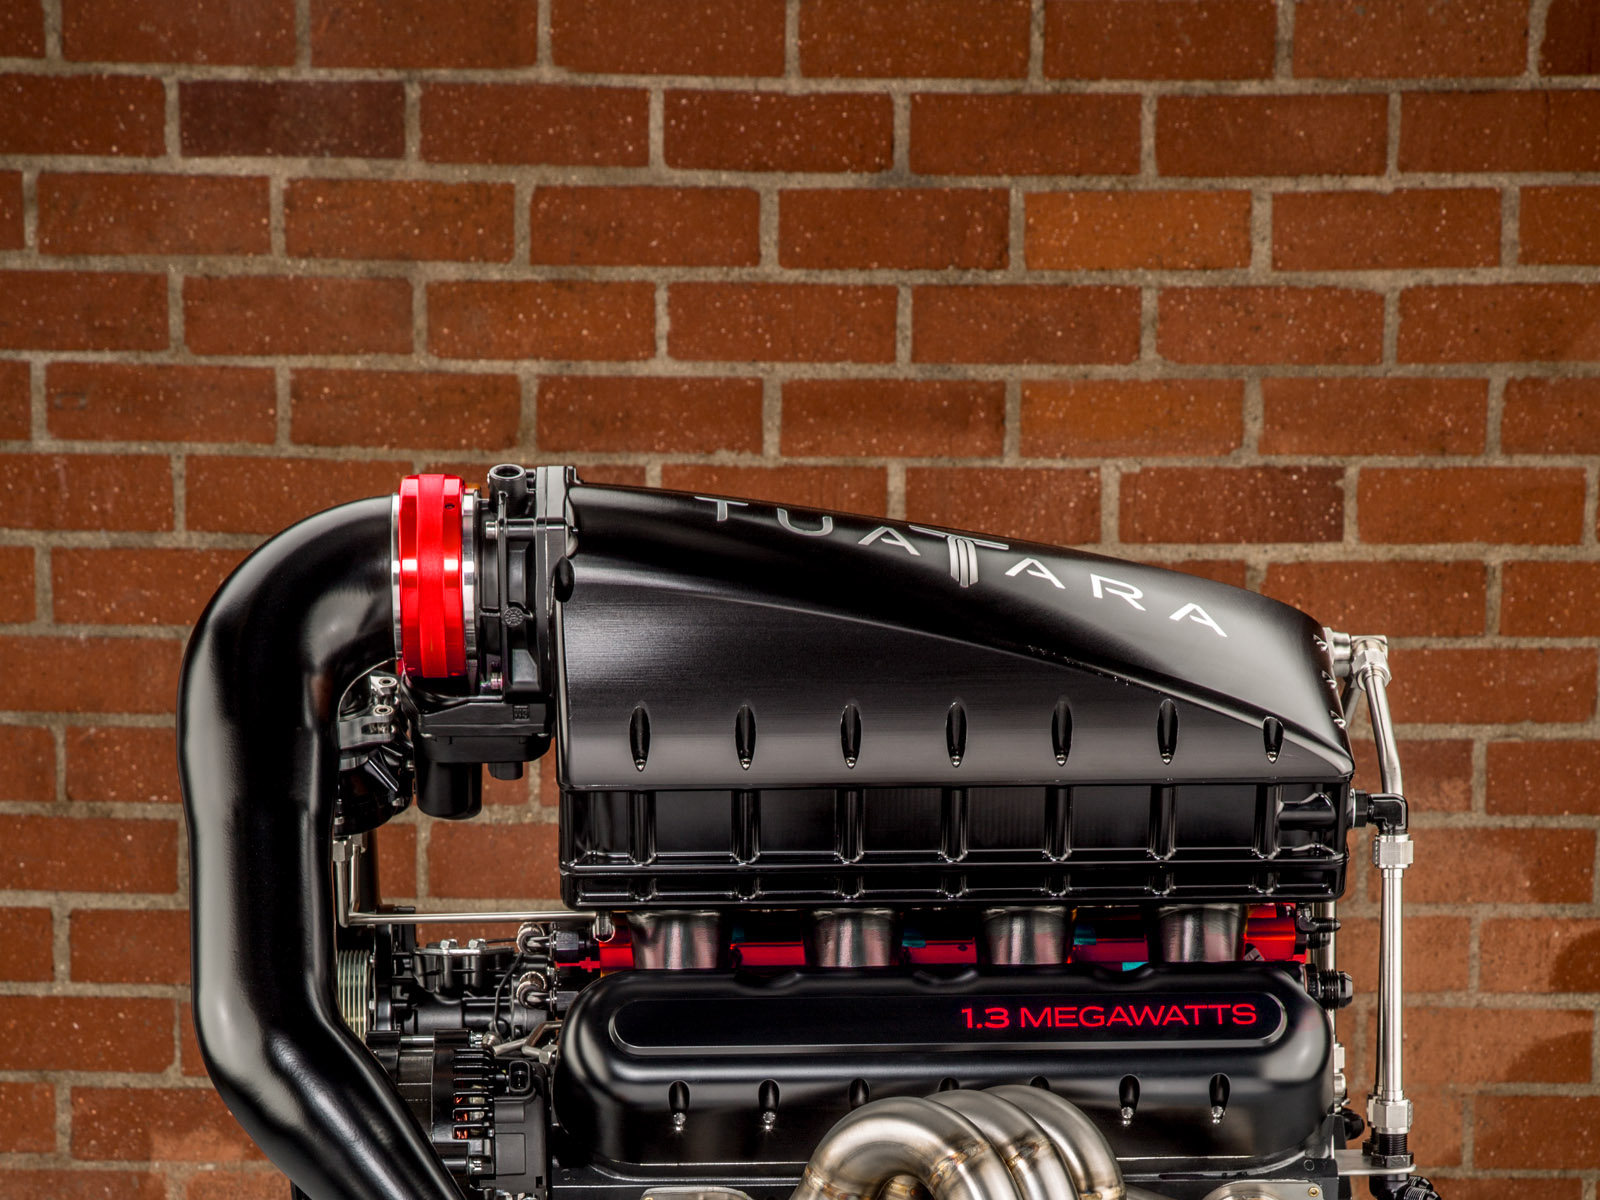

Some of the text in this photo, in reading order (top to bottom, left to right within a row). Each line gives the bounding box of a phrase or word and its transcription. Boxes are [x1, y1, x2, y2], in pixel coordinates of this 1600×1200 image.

[694, 496, 1228, 638] TUATARA
[961, 1003, 1257, 1029] 1.3 MEGAWATTS
